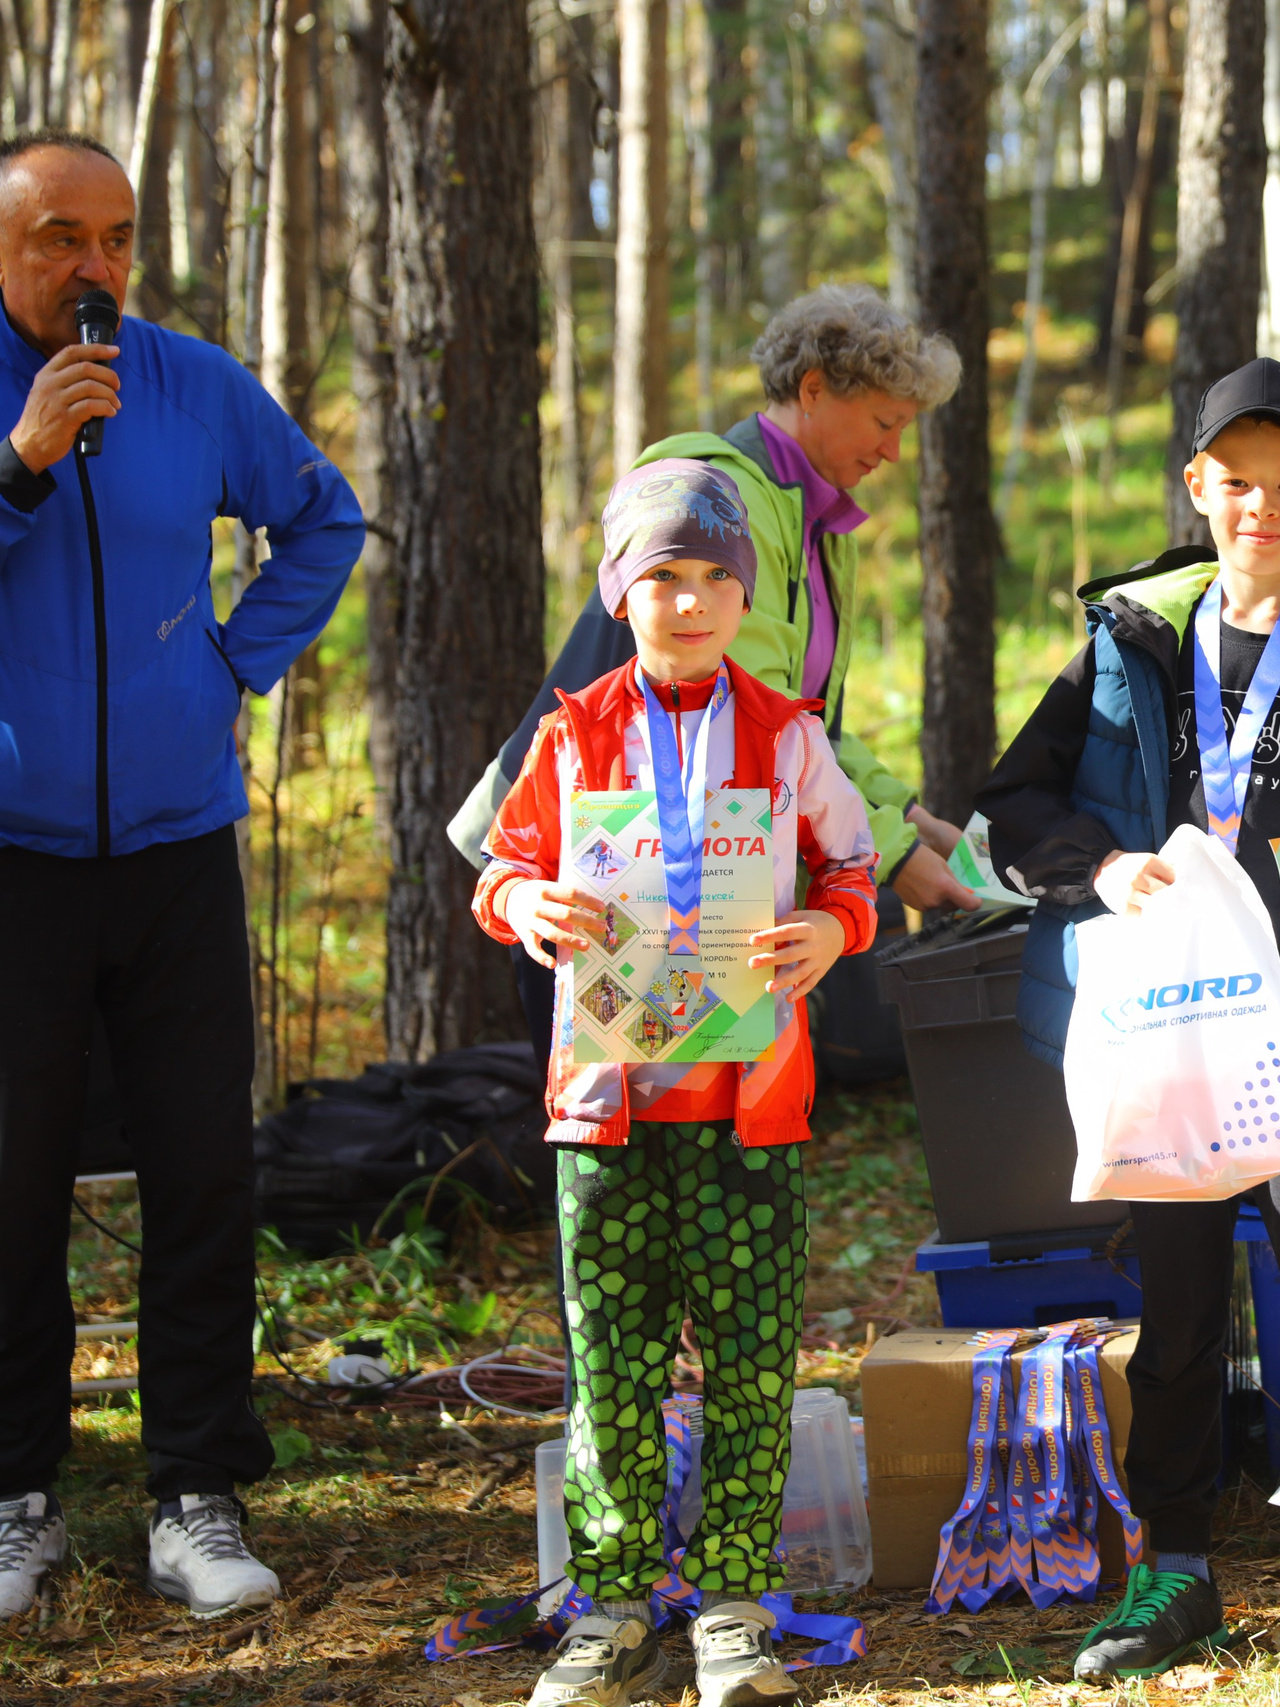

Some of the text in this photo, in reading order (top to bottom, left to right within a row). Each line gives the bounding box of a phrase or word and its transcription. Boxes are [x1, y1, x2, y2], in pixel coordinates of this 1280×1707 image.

[717, 971, 727, 979] 10
[1170, 1009, 1228, 1026] СПОРТИВНАЯ
[1231, 1004, 1267, 1018] ОДЕЖДА
[1102, 1151, 1178, 1168] wintersport45.ru
[977, 1376, 993, 1432] ГОРНЫЙ
[1043, 1364, 1059, 1481] ГОРНЫЙ КОРОЛЬ
[1079, 1368, 1109, 1484] ГОРНЫЙ КОРОЛЬ
[971, 1438, 985, 1492] КОРОЛЬ
[1022, 1432, 1041, 1484] КОРОЛЬ
